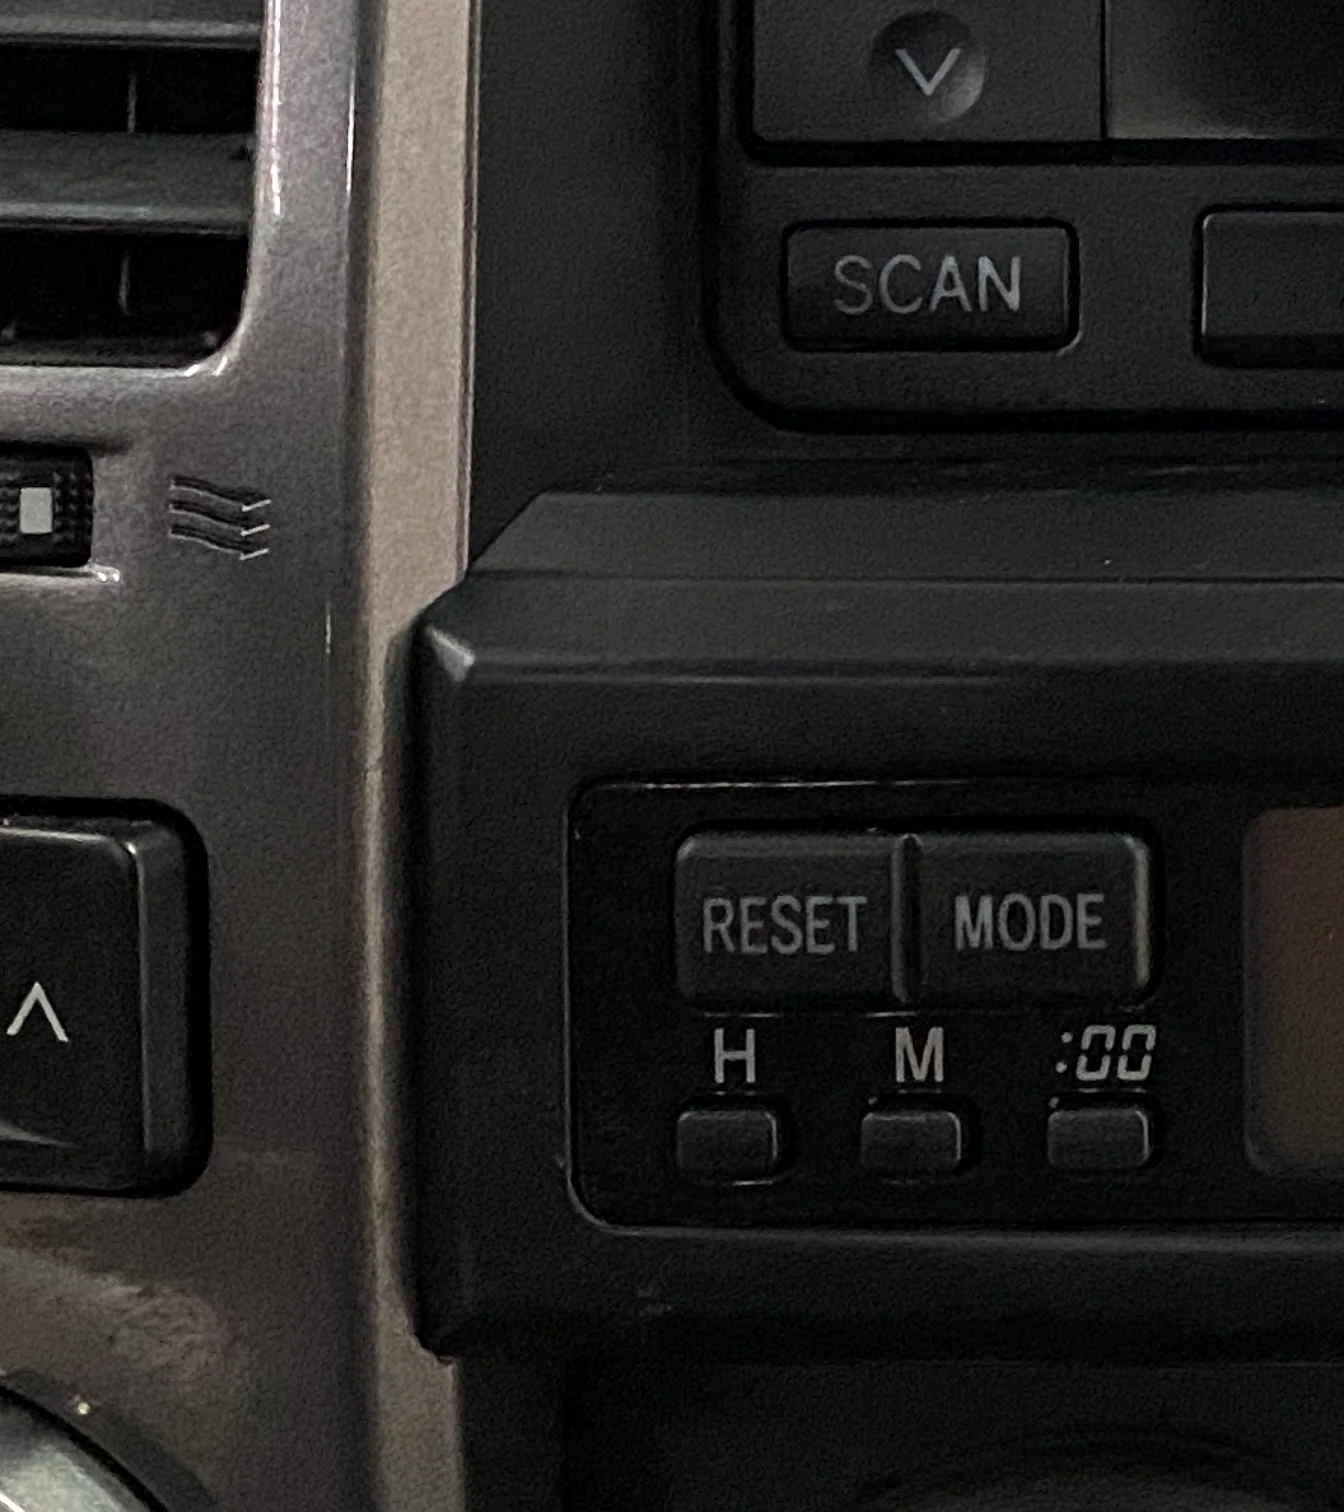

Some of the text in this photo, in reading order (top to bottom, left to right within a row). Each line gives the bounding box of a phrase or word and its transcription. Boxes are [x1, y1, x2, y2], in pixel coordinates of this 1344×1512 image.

[833, 254, 1021, 314] SCAN
[702, 895, 868, 955] RESET
[953, 892, 1107, 952] MODE
[713, 1027, 757, 1084] H
[895, 1026, 945, 1083] M
